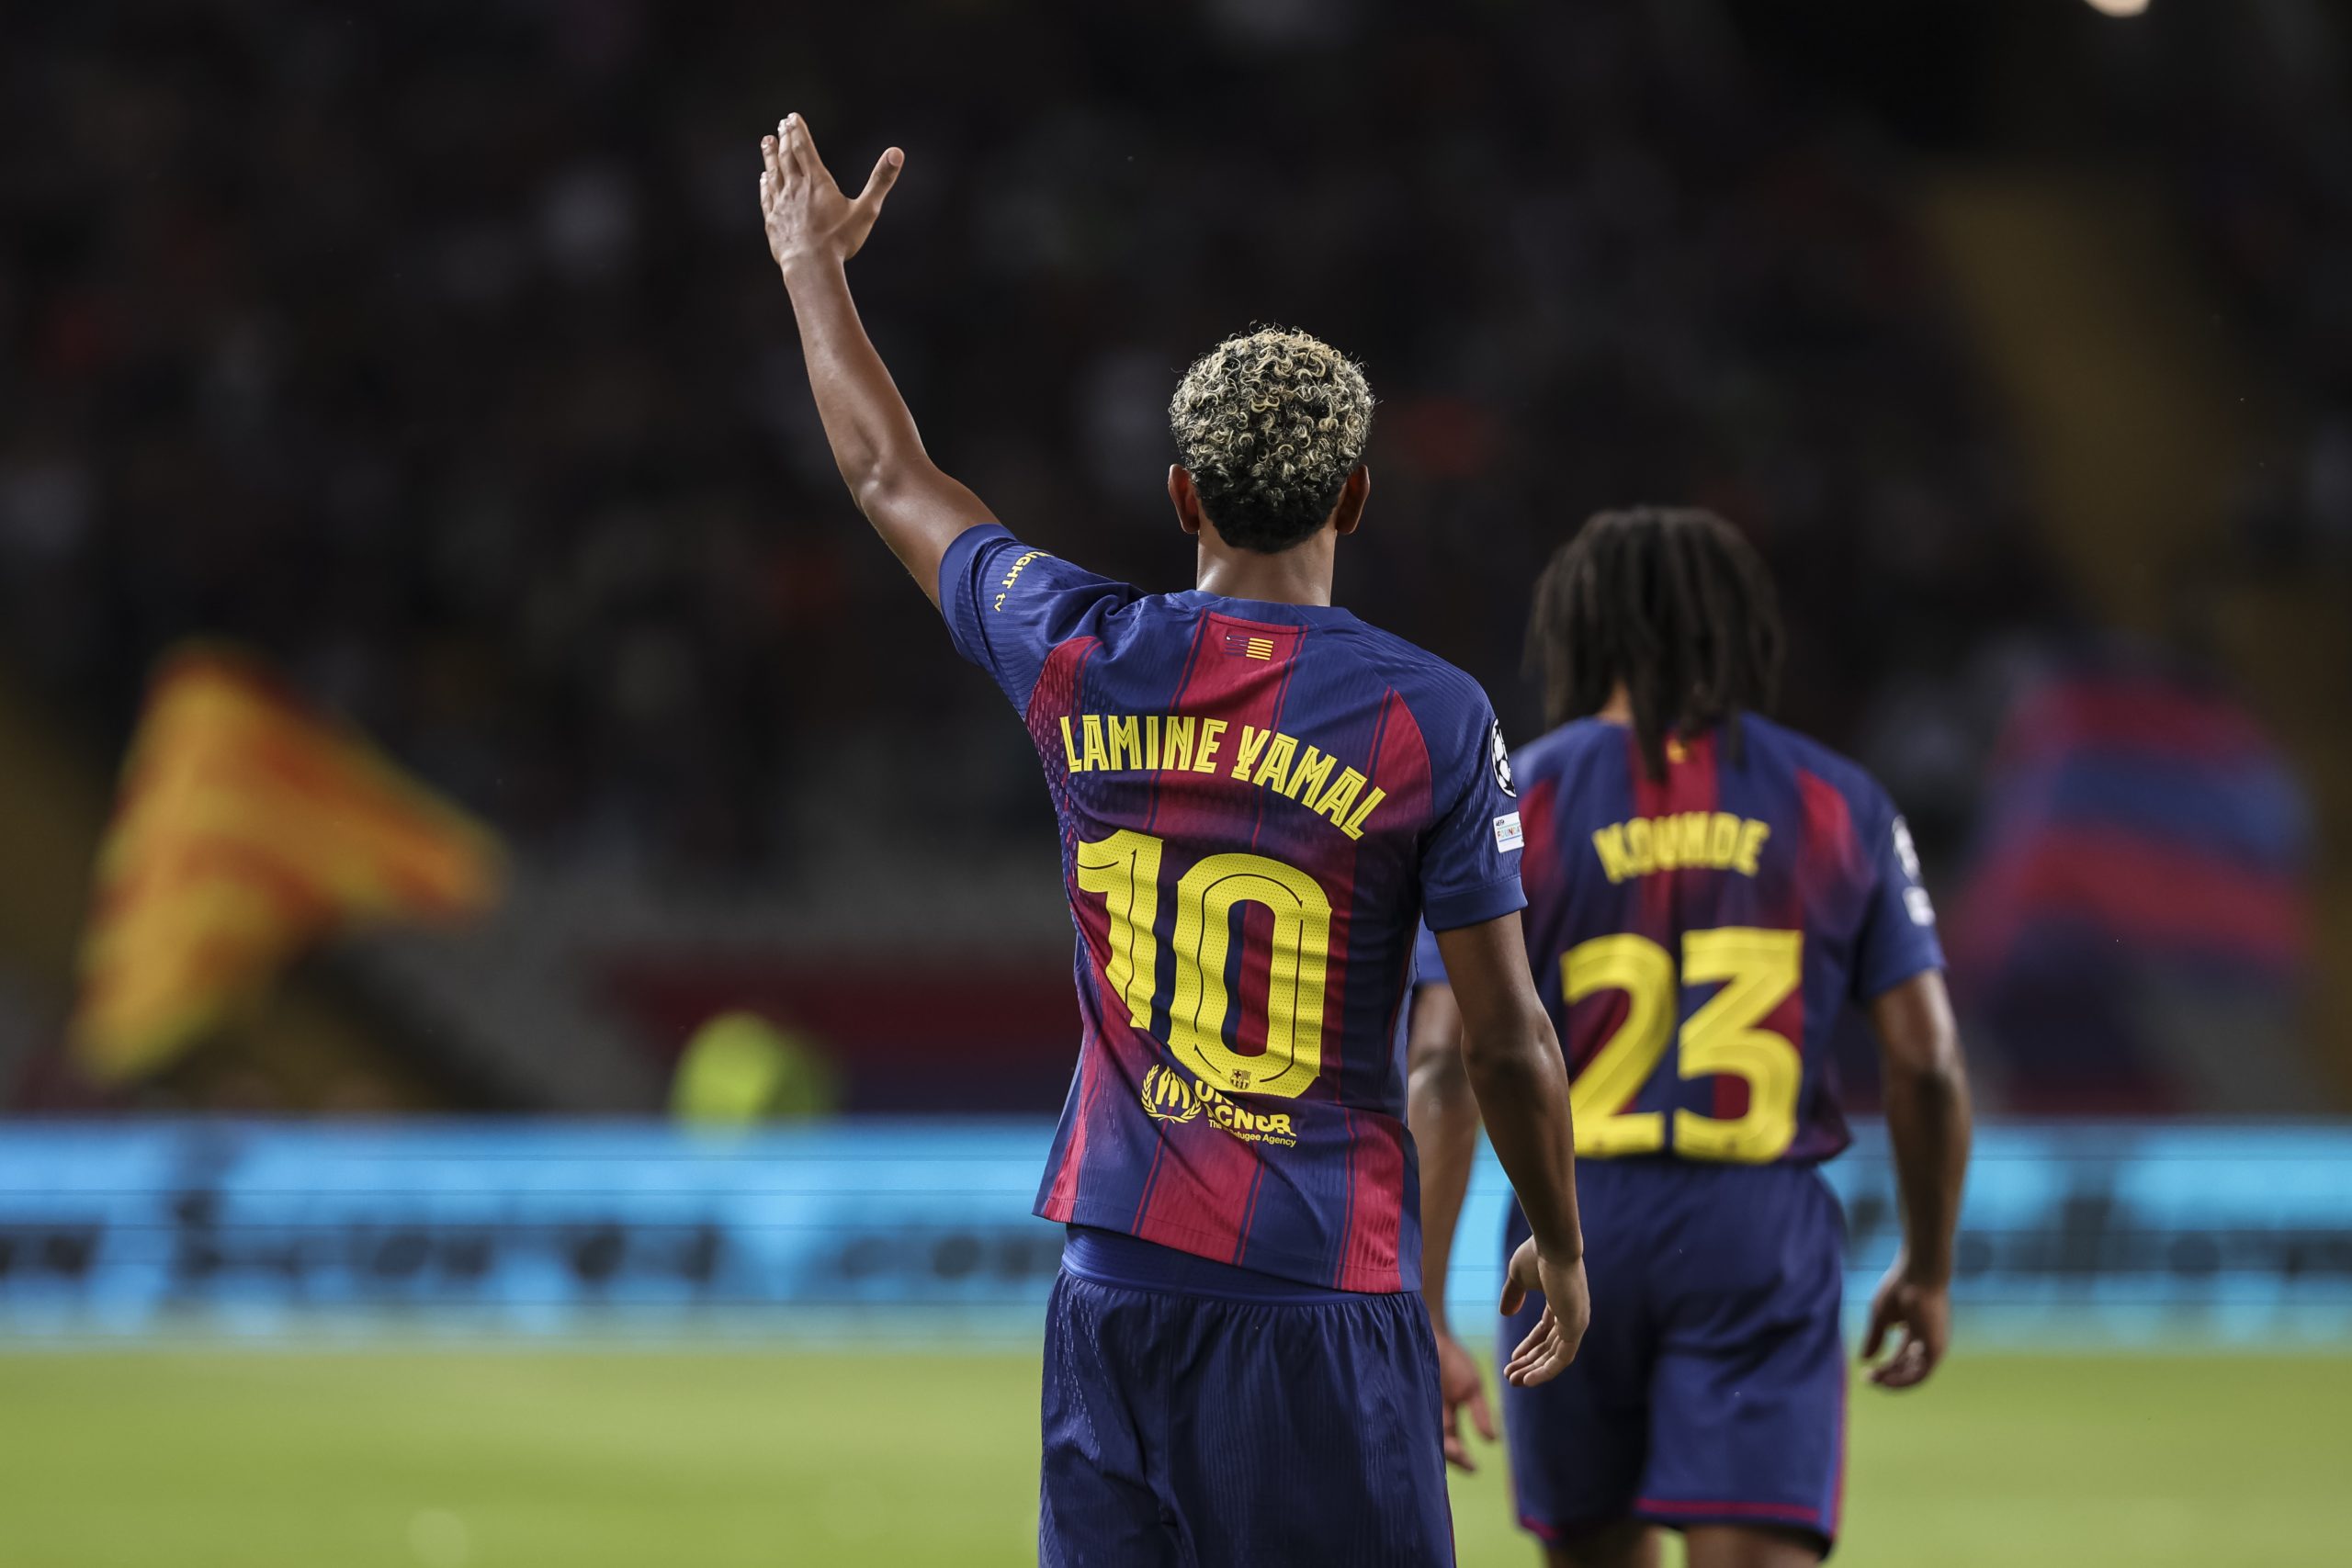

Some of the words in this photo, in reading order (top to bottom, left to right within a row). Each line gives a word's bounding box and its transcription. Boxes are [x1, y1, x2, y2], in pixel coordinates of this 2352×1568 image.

[1059, 715, 1228, 773] LAMINE
[1231, 725, 1386, 841] YAMAL
[1592, 811, 1770, 883] KOUNDE
[1078, 829, 1332, 1098] 10
[1561, 926, 1803, 1163] 23
[1262, 1134, 1296, 1147] Agency
